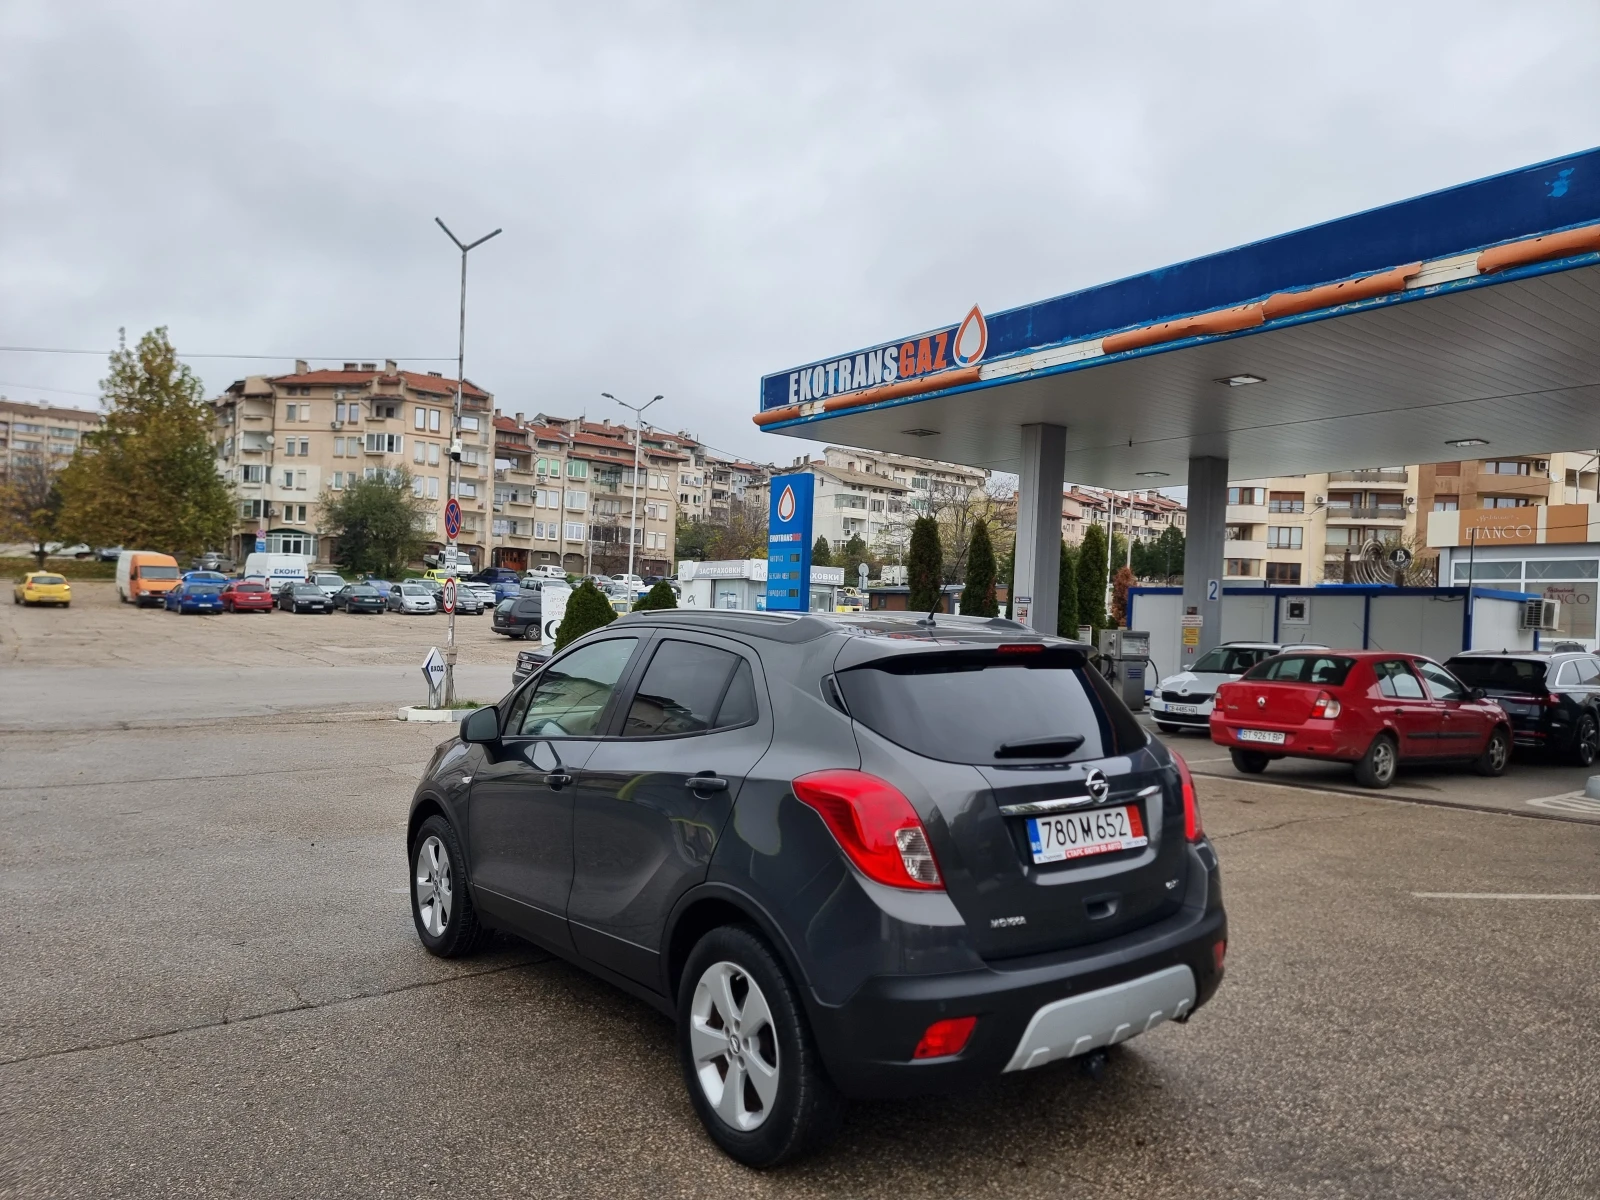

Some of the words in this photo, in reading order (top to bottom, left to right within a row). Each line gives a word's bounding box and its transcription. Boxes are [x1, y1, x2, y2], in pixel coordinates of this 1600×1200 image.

[788, 332, 948, 404] EKOTRANSGAZ
[1465, 524, 1532, 540] BIANCO
[699, 566, 741, 575] ЗАСТРАХОВКИ
[810, 572, 840, 581] ХОВКИ
[445, 587, 454, 604] 30
[1209, 581, 1218, 600] 2
[430, 665, 444, 673] ВХОД
[1041, 818, 1078, 849] 780
[1078, 816, 1094, 843] M
[1096, 812, 1127, 840] 652
